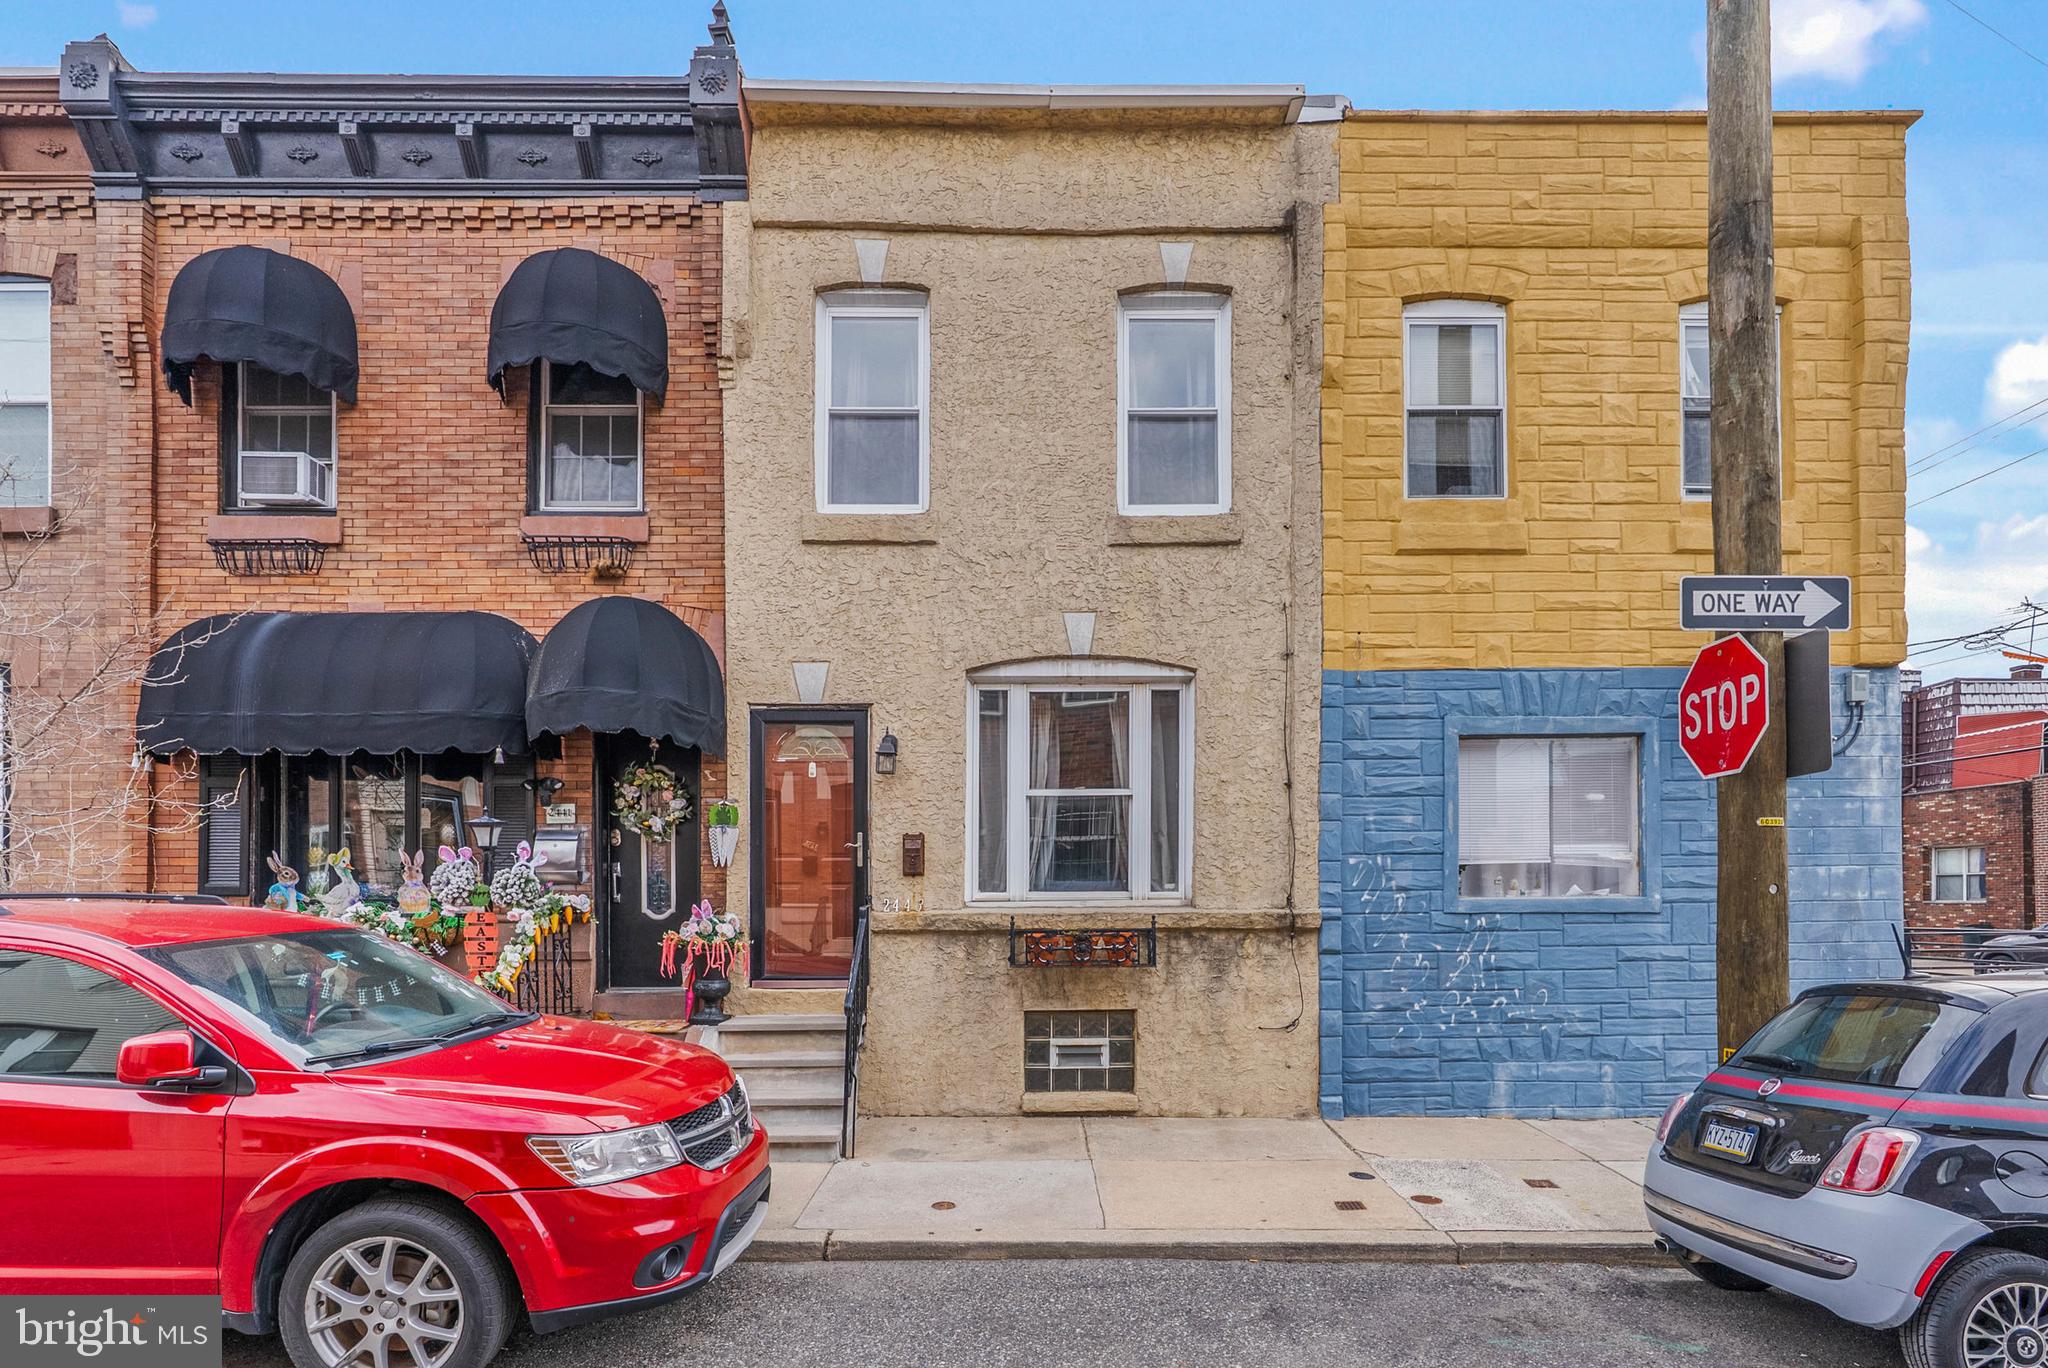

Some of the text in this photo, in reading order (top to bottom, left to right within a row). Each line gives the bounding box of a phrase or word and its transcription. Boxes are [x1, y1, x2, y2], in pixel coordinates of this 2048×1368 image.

[1701, 593, 1801, 613] ONE WAY
[1685, 673, 1761, 740] STOP
[883, 898, 924, 912] 2443
[1788, 1150, 1820, 1164] Gucci
